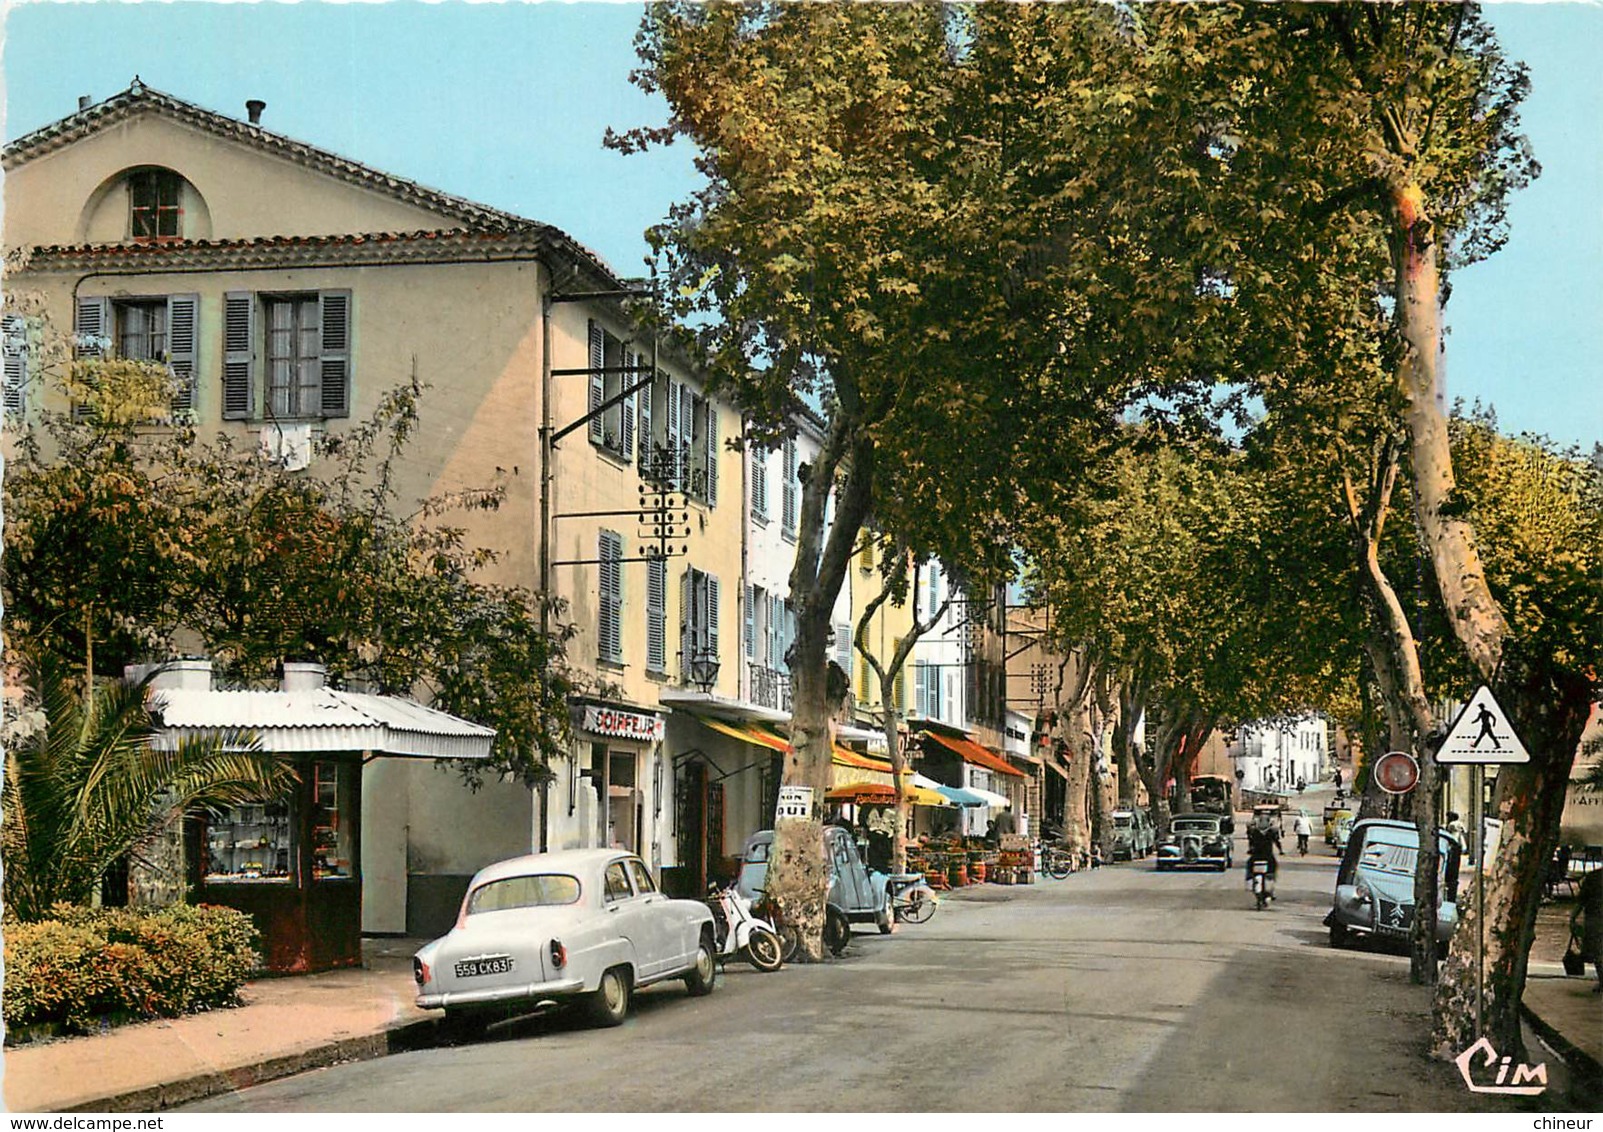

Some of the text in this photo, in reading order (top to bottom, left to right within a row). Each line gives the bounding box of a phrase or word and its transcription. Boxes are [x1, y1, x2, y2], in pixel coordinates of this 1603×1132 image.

[596, 710, 655, 736] COIFFEUR
[777, 806, 806, 816] OUI
[456, 963, 478, 976] 559
